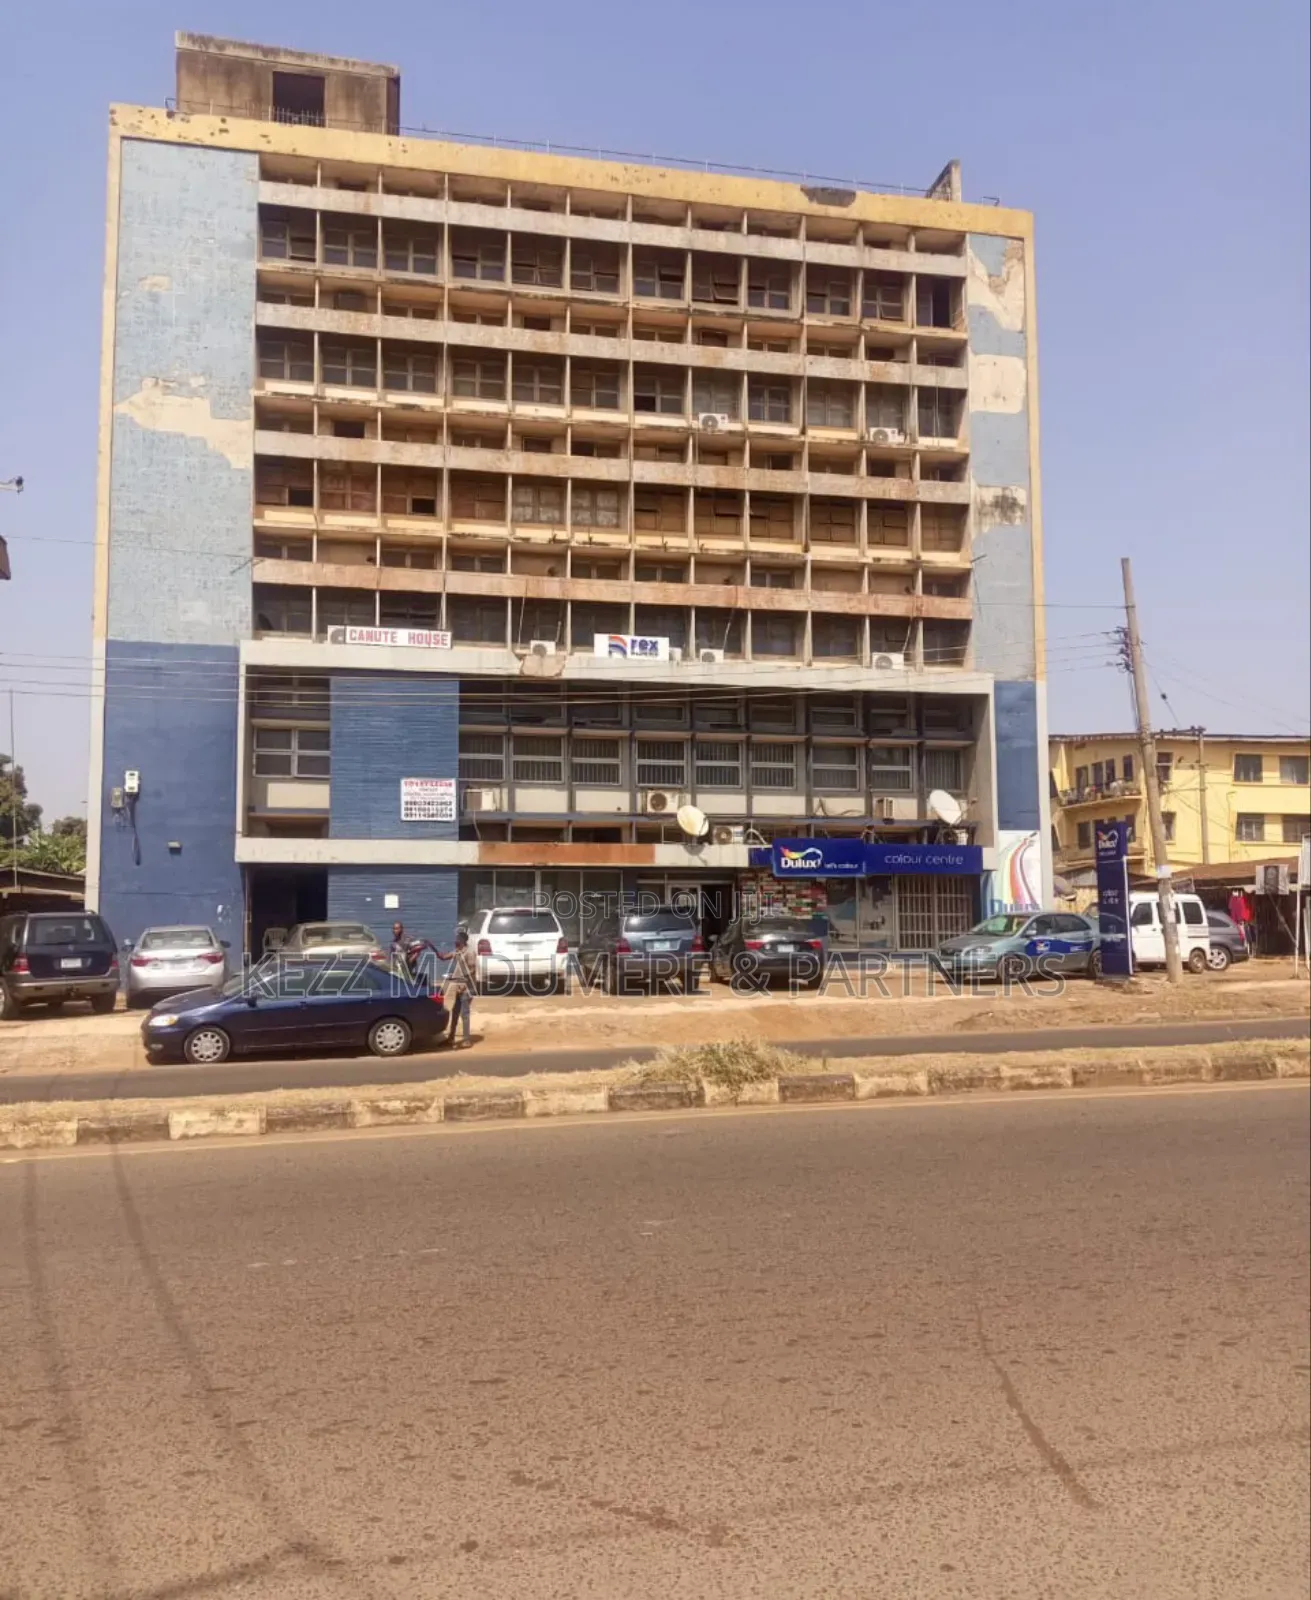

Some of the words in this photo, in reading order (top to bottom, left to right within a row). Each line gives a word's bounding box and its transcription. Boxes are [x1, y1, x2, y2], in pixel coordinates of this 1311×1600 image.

[349, 629, 398, 644] CANUTE
[407, 631, 449, 647] HOUSE
[780, 856, 817, 869] Dulux
[883, 854, 921, 865] colour
[925, 854, 964, 865] centre
